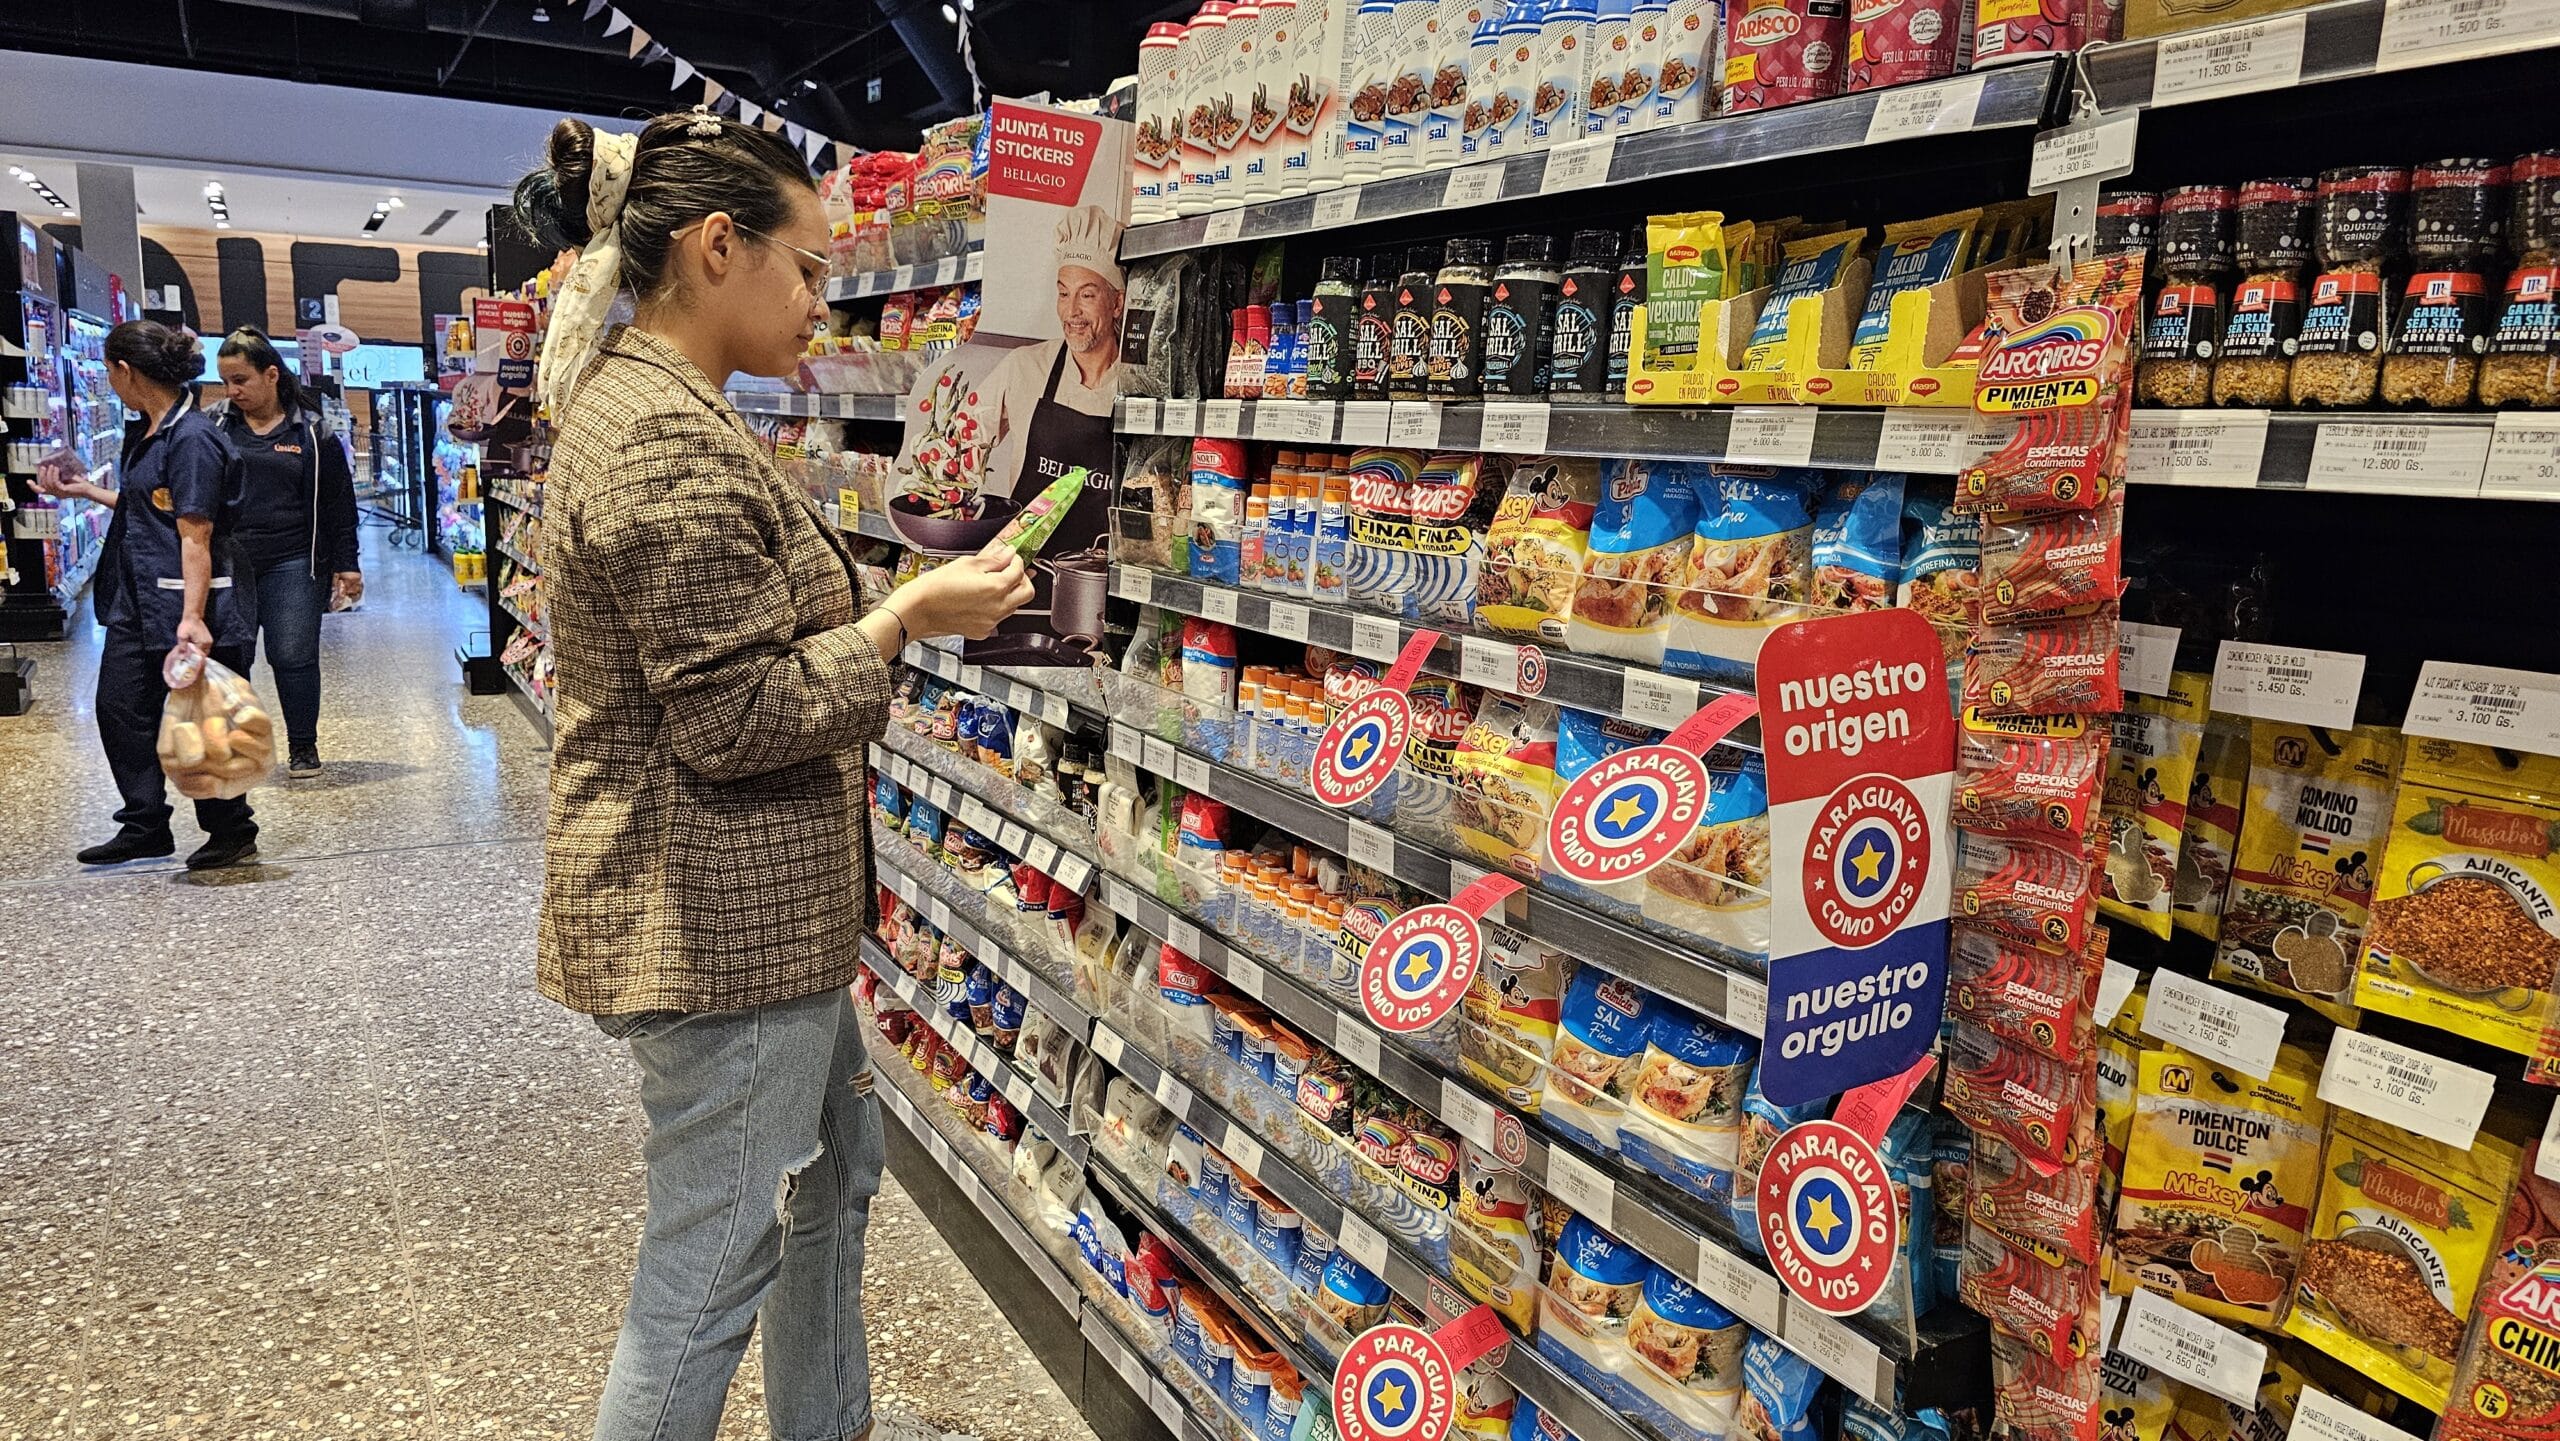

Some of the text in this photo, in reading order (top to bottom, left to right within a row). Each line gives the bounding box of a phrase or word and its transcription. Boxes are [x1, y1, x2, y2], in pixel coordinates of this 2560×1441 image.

[1736, 15, 1800, 42] ARISCO
[2439, 17, 2505, 37] 11.500 Gs.
[2198, 60, 2252, 79] 11.500 Gs.
[996, 117, 1085, 147] JUNTÁ TUS
[995, 138, 1074, 167] STICKERS
[1003, 166, 1066, 188] BELLAGIO
[2436, 178, 2480, 188] GRINDER
[1668, 248, 1699, 260] Maggi
[1887, 252, 1927, 276] CALDO
[1662, 268, 1698, 289] CALDO
[1782, 260, 1813, 281] CALDO
[308, 300, 322, 319] 2
[2233, 313, 2271, 324] GARLIC
[2308, 306, 2345, 317] GARLIC
[2413, 306, 2460, 318] GARLIC
[2507, 303, 2558, 316] GARLIC
[1394, 320, 1415, 339] SAL
[1433, 319, 1454, 338] SAL
[1489, 317, 1510, 336] SAL
[1557, 313, 1579, 333] SAL
[2227, 323, 2275, 334] SEA SALT
[2304, 316, 2350, 328] SEA SALT
[2406, 318, 2464, 329] SEA SALT
[2500, 314, 2560, 327] SEA SALT
[1359, 324, 1378, 341] SAL
[2223, 338, 2275, 347] GRINDER
[2299, 330, 2350, 341] GRINDER
[2402, 333, 2465, 343] GRINDER
[2496, 331, 2560, 342] GRINDER
[1988, 342, 2099, 376] ARCOIRIS
[1682, 372, 1705, 385] CALDOS
[1867, 373, 1897, 387] CALDOS
[1678, 387, 1706, 400] EN POLVO
[1864, 389, 1900, 402] EN POLVO
[1986, 380, 2088, 403] PIMIENTA
[2011, 398, 2057, 410] MOLIDA
[2027, 445, 2089, 458] ESPECIAS
[2160, 455, 2212, 467] 11.500 Gs.
[2024, 457, 2086, 469] Condimentos
[2362, 457, 2424, 471] 12.800 Gs.
[1358, 520, 1413, 541] FINA
[1418, 530, 1464, 543] FINA
[1364, 535, 1403, 548] YODADA
[1421, 543, 1456, 553] YODADA
[2045, 541, 2108, 561] ESPECIAS
[2046, 555, 2106, 570] Condimentos
[2043, 653, 2106, 667] ESPECIAS
[2044, 666, 2105, 678] Condimentos
[1779, 660, 1928, 712] nuestro
[2257, 680, 2306, 697] 5.450 Gs.
[2436, 678, 2461, 690] PICANTE
[2462, 680, 2489, 693] MASSABOR
[2490, 683, 2506, 695] 20GR
[1335, 697, 1405, 748] PARAGUAYO
[1996, 723, 2048, 736] MOLIDA
[2456, 710, 2515, 729] 3.100 Gs.
[1783, 707, 1911, 757] origen
[1319, 757, 1375, 798] COMO VOS
[1589, 753, 1697, 823] PARAGUAYO
[2015, 772, 2079, 789] ESPECIAS
[2014, 783, 2076, 799] Condimentos
[2301, 784, 2359, 816] COMINO
[1812, 785, 1922, 863] PARAGUAYO
[2294, 806, 2354, 837] MOLIDO
[2446, 803, 2545, 850] Massabor
[1559, 816, 1646, 873] COMO VOS
[2268, 853, 2342, 896] Mickey
[2014, 879, 2076, 902] ESPECIAS
[2465, 854, 2555, 921] AJÍ PICANTE
[1821, 882, 1915, 937] COMO VOS
[2012, 891, 2074, 913] Condimentos
[1339, 932, 1363, 959] SAL
[1391, 913, 1473, 981] PARAGUAYO
[1489, 927, 1522, 956] YODADA
[1368, 966, 1432, 1024] COMO VOS
[1599, 986, 1635, 1015] Primicia
[1785, 960, 1929, 1022] nuestro
[2006, 981, 2064, 1009] ESPECIAS
[2002, 991, 2061, 1020] Condimentos
[1594, 1005, 1622, 1031] SAL
[1588, 1021, 1615, 1046] Fina
[1780, 998, 1913, 1060] orgullo
[2188, 1024, 2232, 1049] 2.150 Gs.
[1213, 1034, 1231, 1055] Fina
[1240, 1057, 1260, 1076] Fina
[1277, 1050, 1297, 1072] Celusal
[2358, 1041, 2379, 1057] PICANTE
[2380, 1048, 2406, 1066] MASSABOR
[2406, 1058, 2420, 1071] 20GR
[2421, 1062, 2433, 1076] PAQ
[1272, 1078, 1294, 1100] Fina
[2004, 1080, 2059, 1113] ESPECIAS
[2373, 1078, 2425, 1106] 3.100 Gs.
[2250, 1091, 2302, 1112] CONDIMENTOS
[2177, 1109, 2271, 1141] PIMENTON
[2193, 1129, 2249, 1157] DULCE
[1200, 1176, 1219, 1196] Fina
[1410, 1181, 1441, 1200] FINA
[1777, 1134, 1888, 1244] PARAGUAYO
[2163, 1170, 2250, 1214] Mickey
[2364, 1168, 2447, 1220] Massabor
[2169, 1203, 2207, 1216] obligación
[1587, 1234, 1613, 1259] SAL
[1996, 1225, 2037, 1255] MOLIDA
[1768, 1212, 1861, 1300] COMO VOS
[2376, 1214, 2447, 1290] AJÍ PICANTE
[1297, 1252, 1323, 1275] Fina
[1334, 1255, 1357, 1280] SAL
[2140, 1309, 2167, 1329] CONDIMENTO
[2165, 1349, 2210, 1379] 2.550 Gs.
[1373, 1334, 1446, 1440] PARAGUAYO
[1341, 1373, 1364, 1438] COMO
